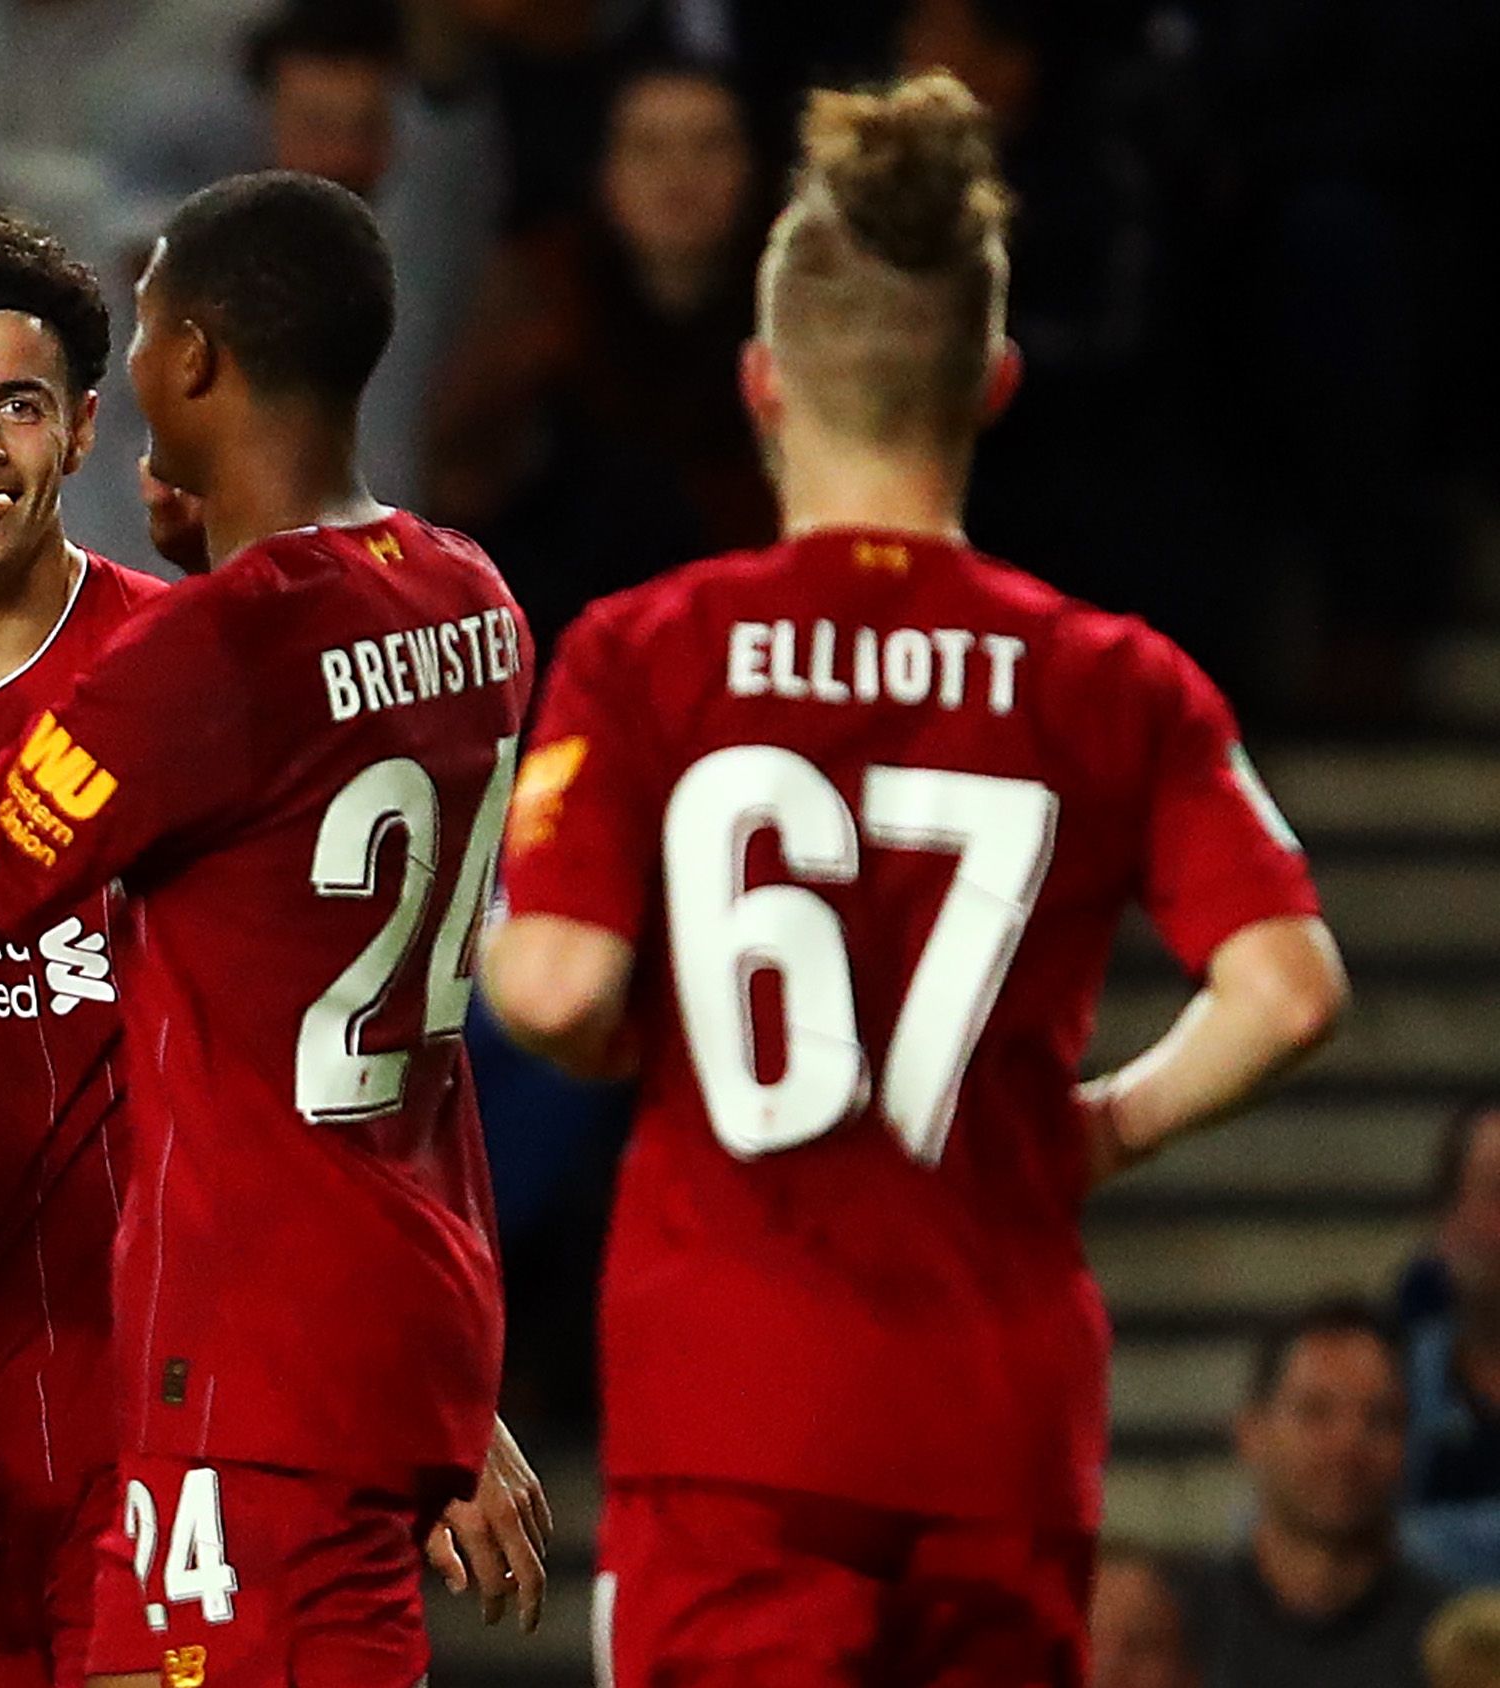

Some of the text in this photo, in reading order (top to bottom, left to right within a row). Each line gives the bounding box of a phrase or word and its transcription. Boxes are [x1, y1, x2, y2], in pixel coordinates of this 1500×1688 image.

[321, 605, 521, 722] BREWSTER
[726, 618, 1026, 714] ELLIOTT
[19, 709, 118, 821] WU
[663, 743, 1060, 1168] 67
